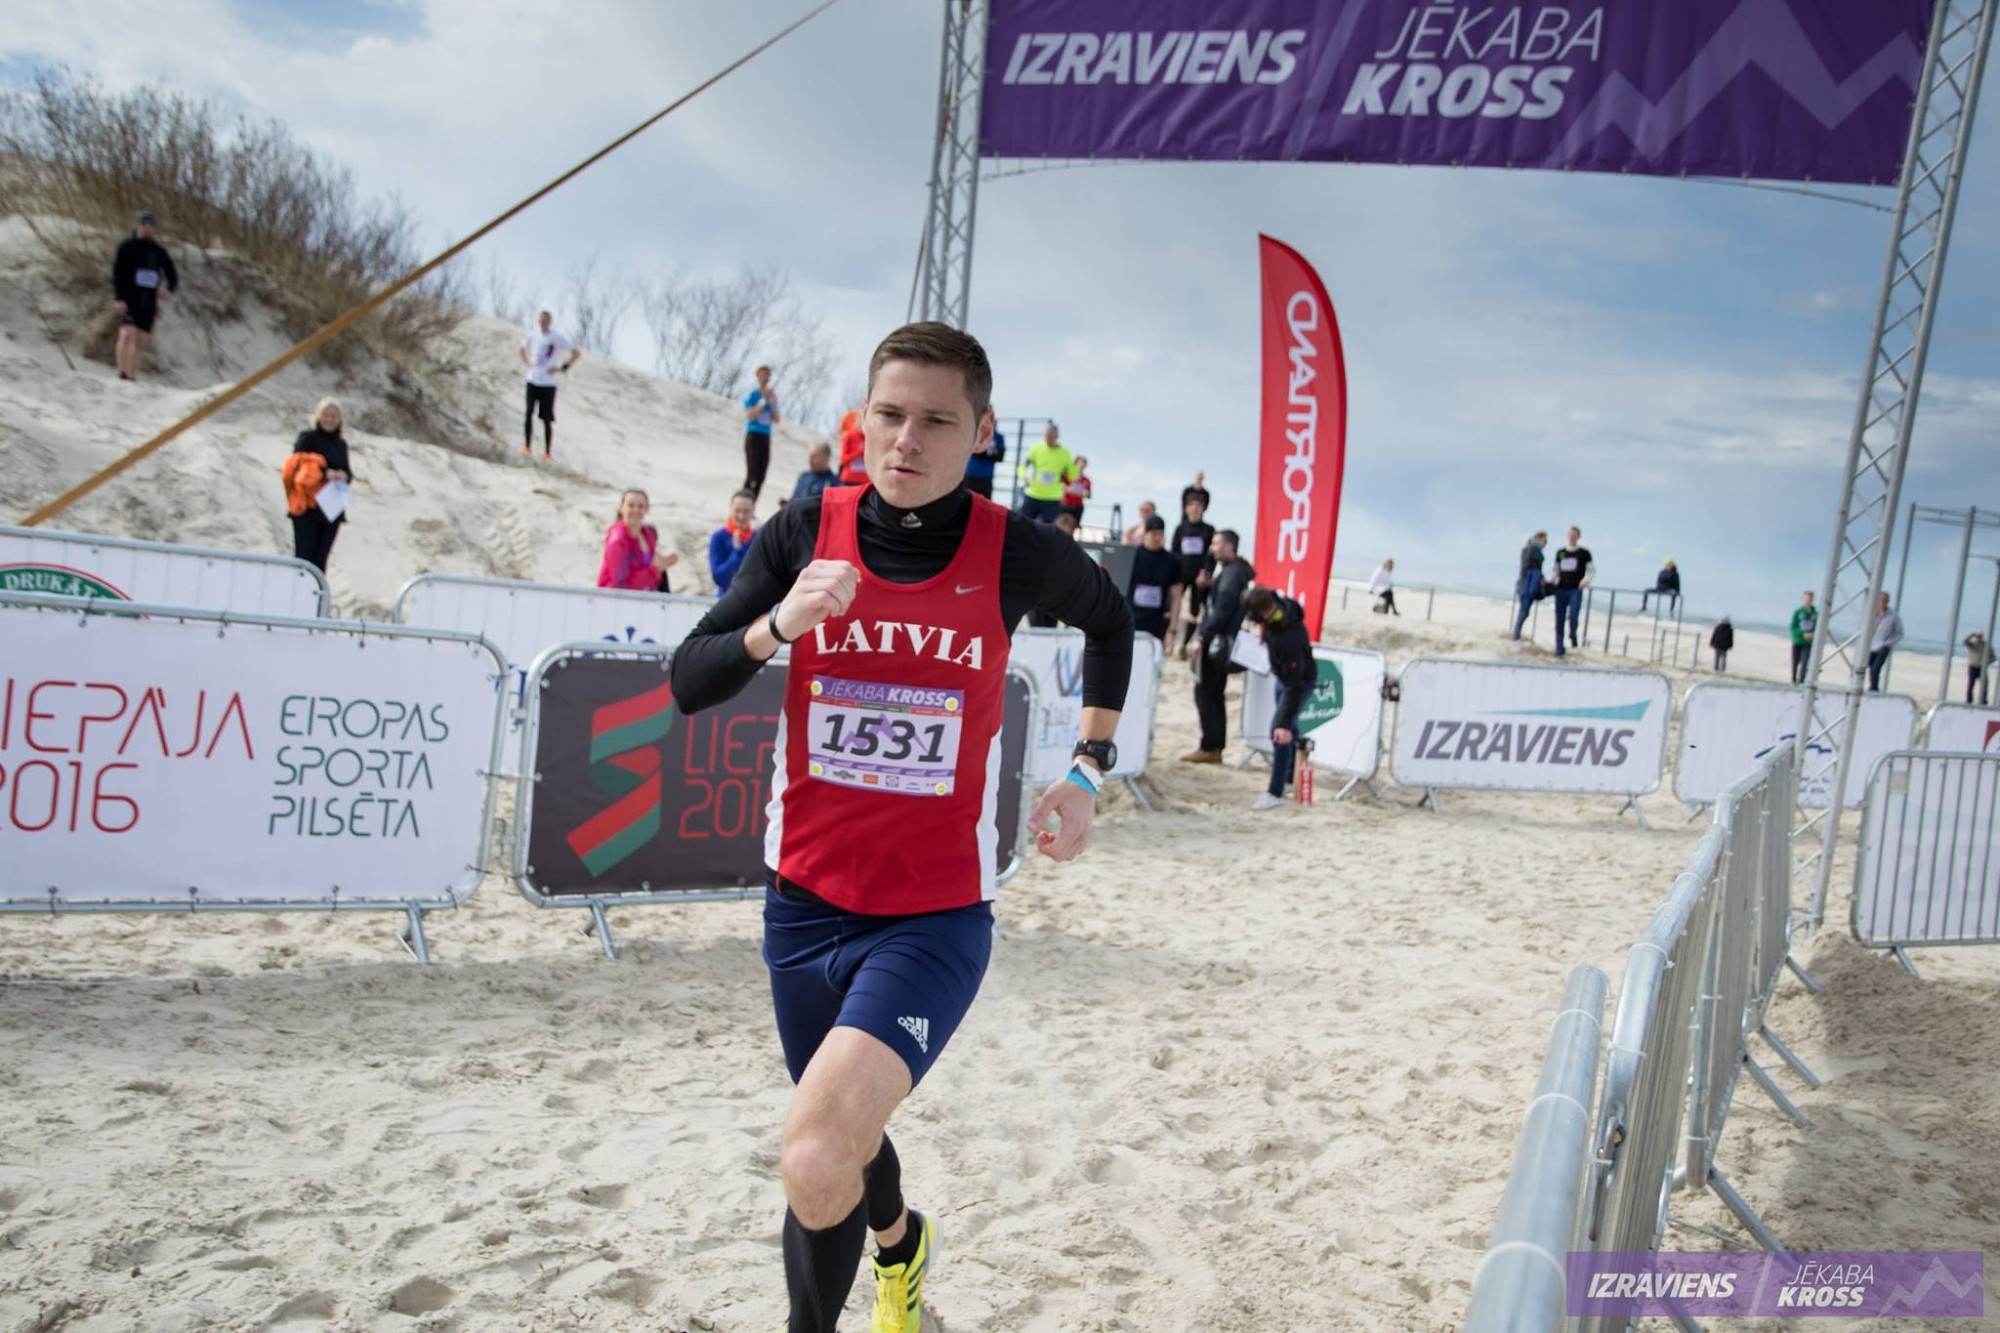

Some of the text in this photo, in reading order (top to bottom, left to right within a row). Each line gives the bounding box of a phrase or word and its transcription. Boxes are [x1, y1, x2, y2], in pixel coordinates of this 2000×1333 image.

[1341, 62, 1574, 119] KROSS
[814, 619, 983, 671] LATVIA
[280, 695, 449, 742] EIROPAS
[887, 687, 947, 707] KROSS
[821, 713, 945, 763] 1531
[274, 745, 433, 790] SPORTA
[269, 792, 419, 838] PILSĒTA
[678, 777, 771, 838] 201
